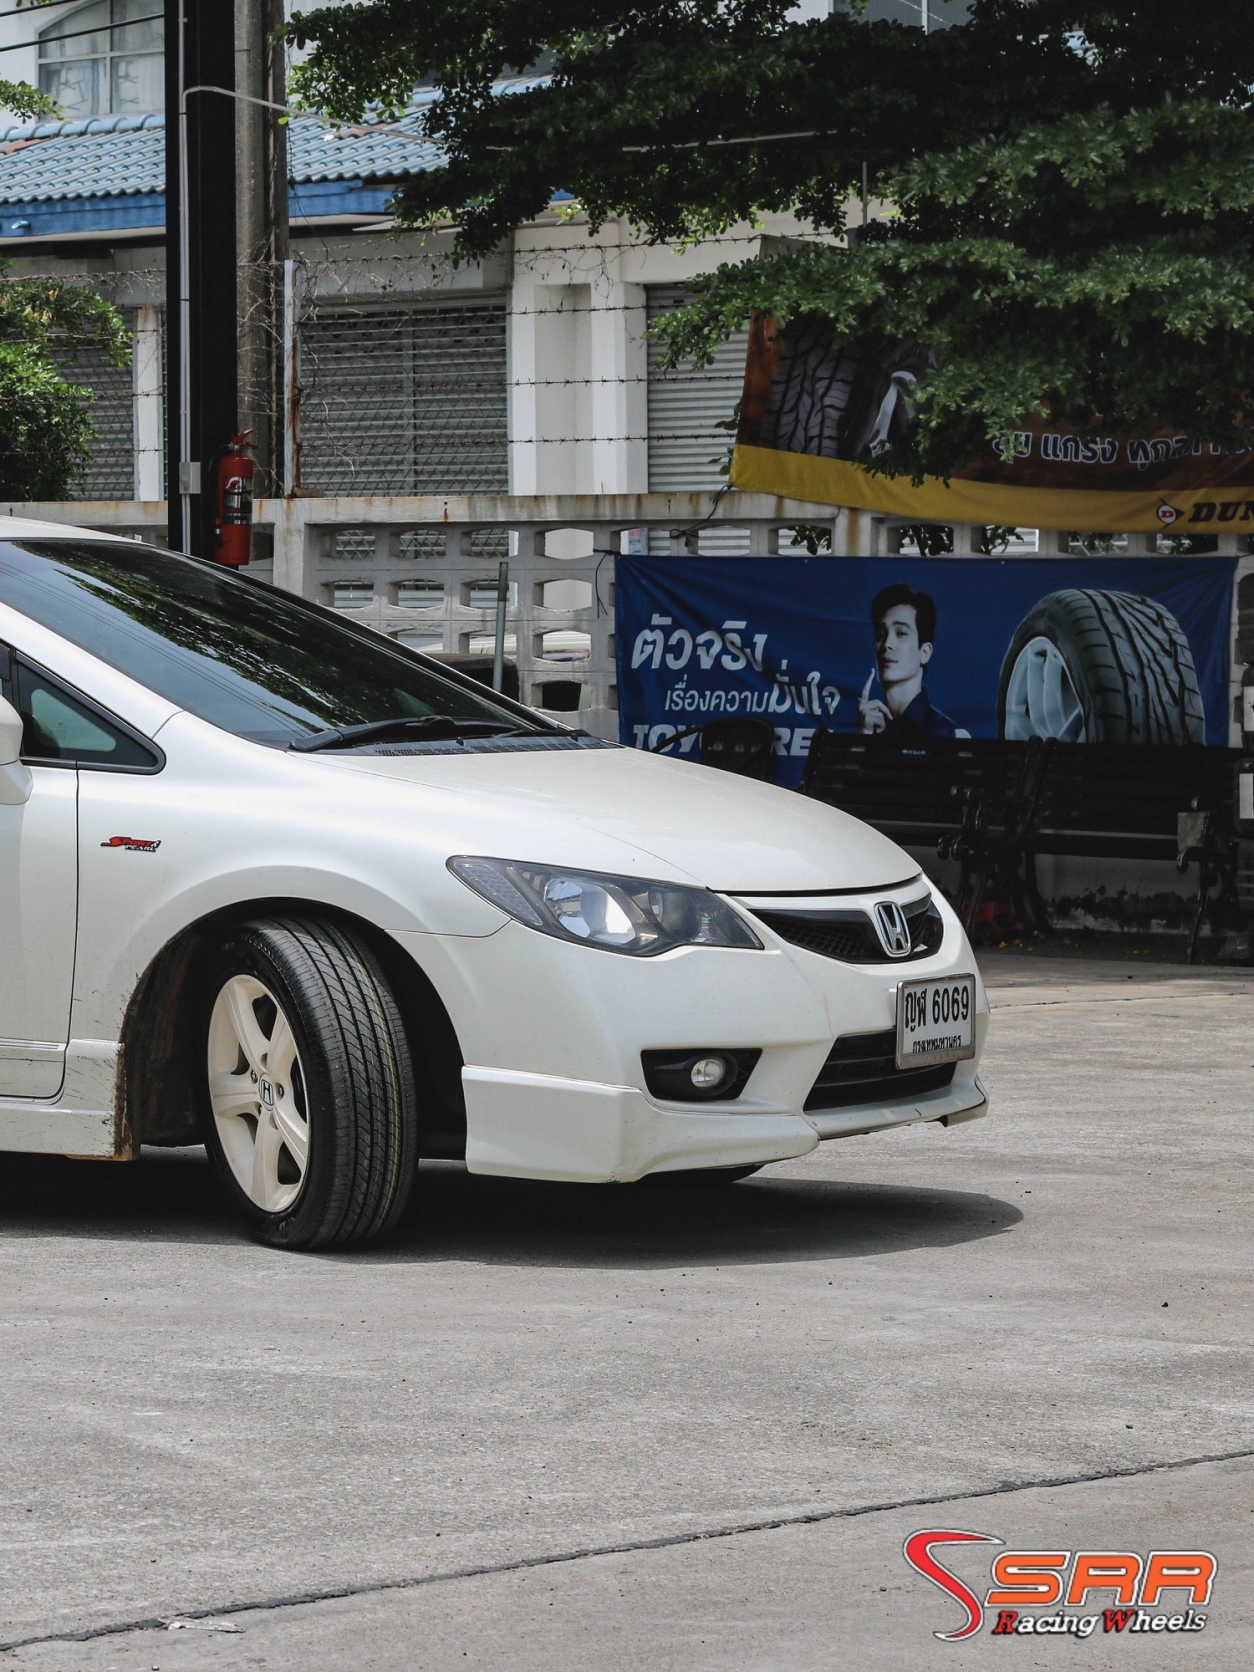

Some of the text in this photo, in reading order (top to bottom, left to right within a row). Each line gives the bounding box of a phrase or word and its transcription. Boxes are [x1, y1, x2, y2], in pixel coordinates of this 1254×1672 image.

[630, 613, 768, 672] ตัวจริง
[664, 659, 841, 715] เรื่องความมั่นใจ
[633, 724, 703, 752] TOY
[932, 985, 969, 1025] 6069
[912, 1034, 962, 1054] กรงเทพมหานคร
